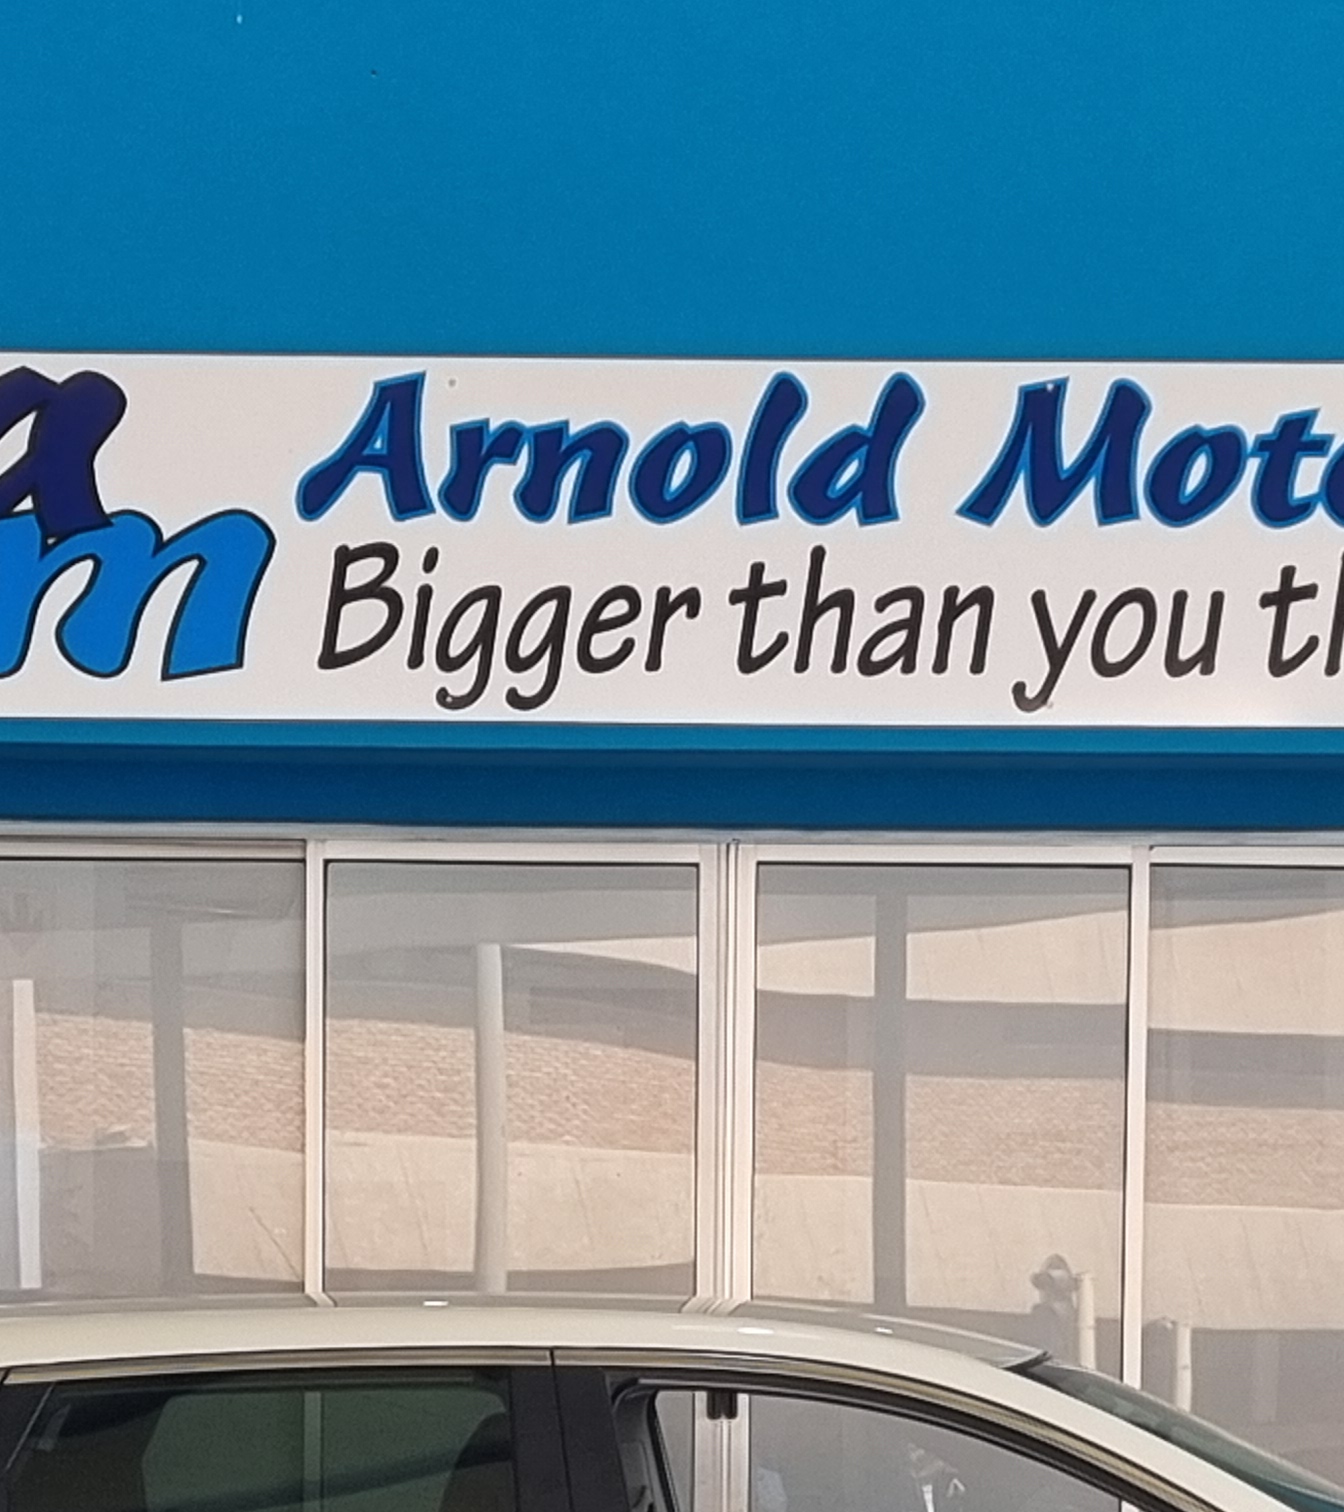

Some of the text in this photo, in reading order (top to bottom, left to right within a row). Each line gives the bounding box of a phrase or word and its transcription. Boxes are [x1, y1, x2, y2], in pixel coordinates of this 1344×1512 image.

[296, 370, 926, 527] Arnold
[317, 541, 702, 711] Bigger
[729, 545, 994, 677] than
[1011, 586, 1225, 713] you
